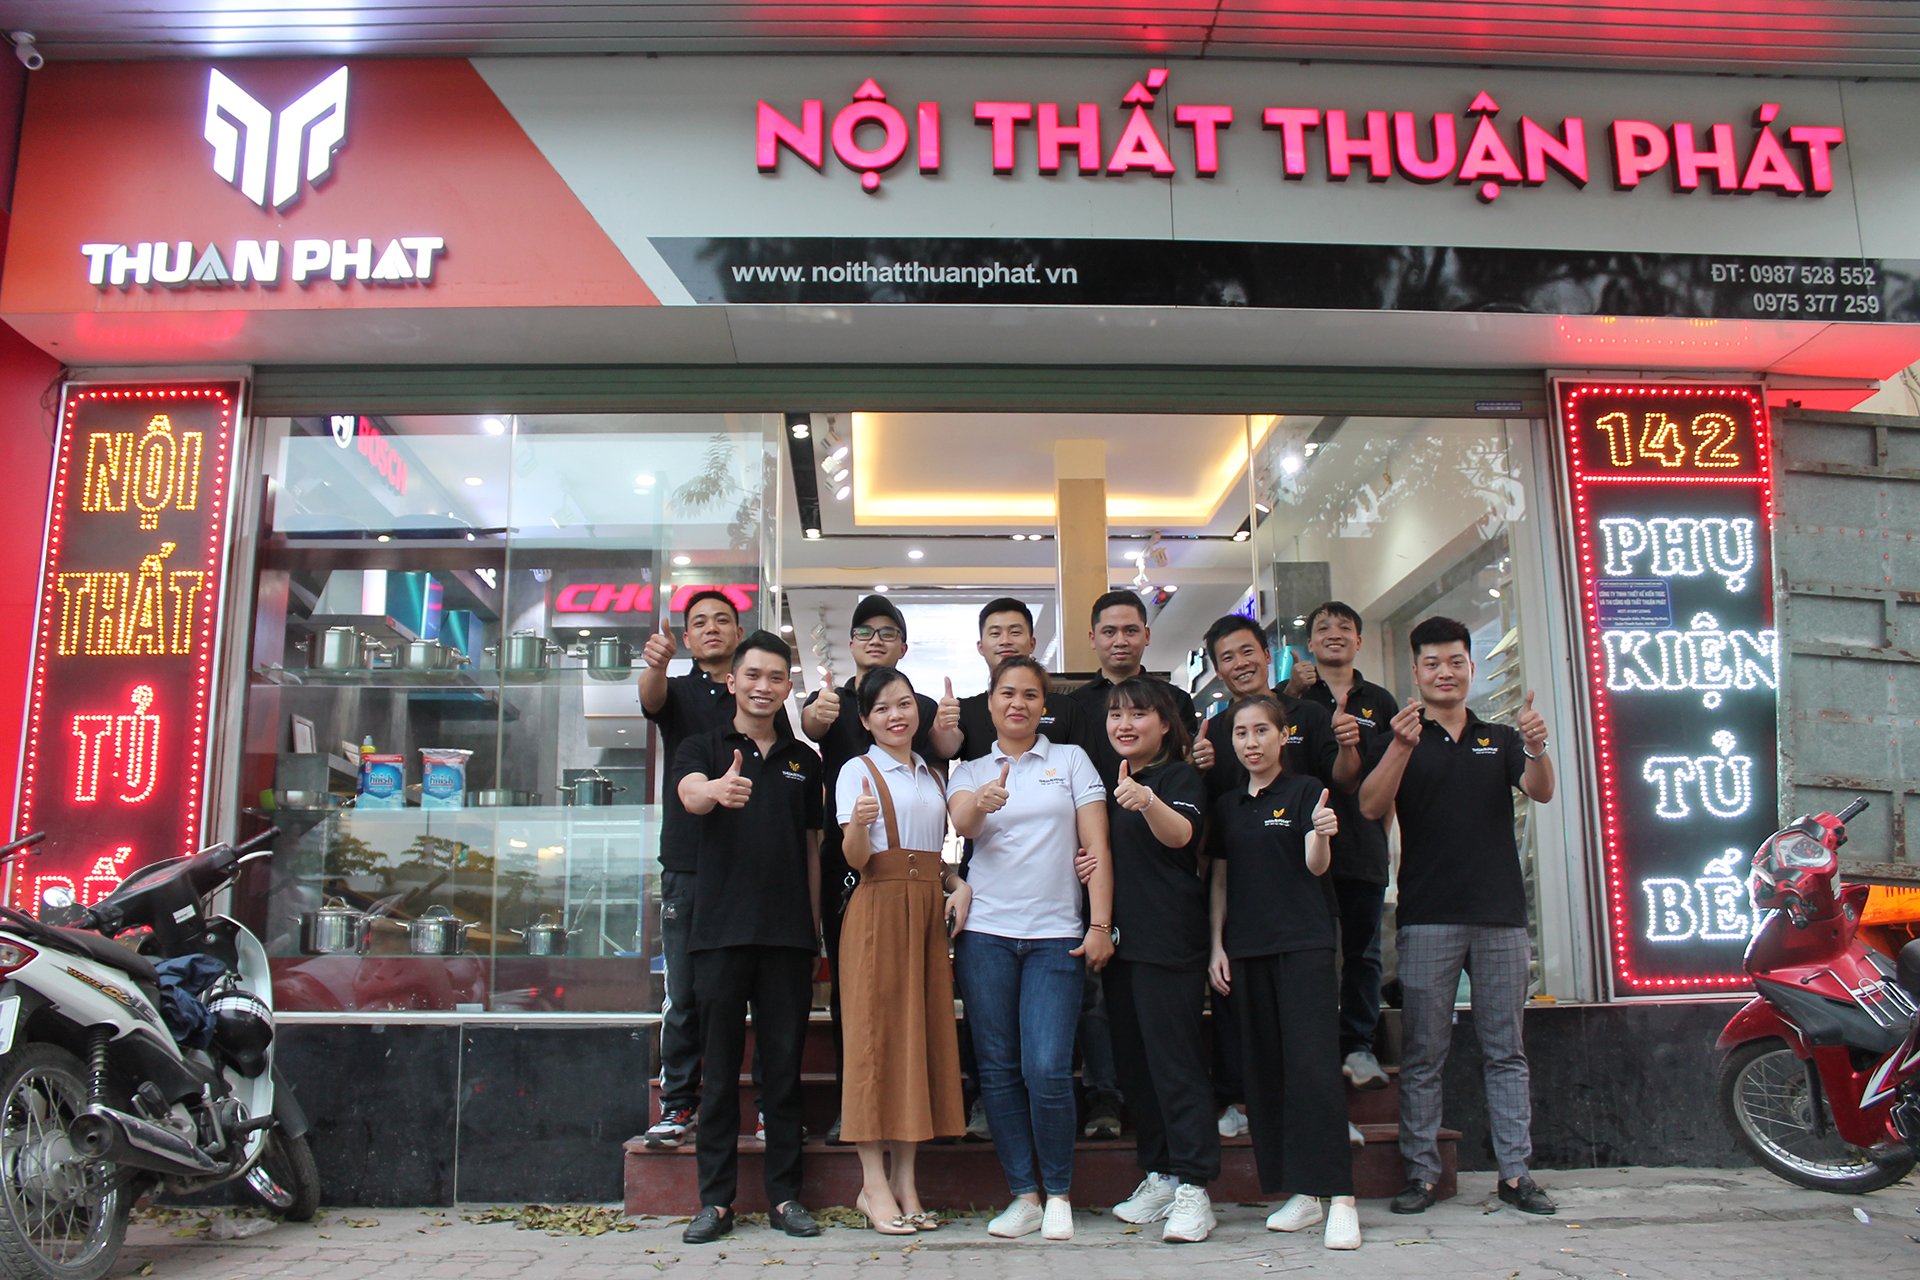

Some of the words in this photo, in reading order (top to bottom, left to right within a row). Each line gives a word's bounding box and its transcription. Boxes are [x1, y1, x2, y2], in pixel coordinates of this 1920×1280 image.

[756, 77, 940, 191] NỘI
[973, 68, 1233, 176] THẤT
[1263, 90, 1589, 202] THUẬN
[1610, 103, 1844, 195] PHÁT
[291, 236, 445, 284] PHAT
[1711, 264, 1745, 283] ĐT:
[1750, 265, 1796, 284] 0987
[1801, 266, 1836, 285] 528
[1840, 267, 1876, 286] 552
[1753, 293, 1800, 312] 0975
[1804, 294, 1839, 313] 377
[1844, 294, 1880, 314] 259
[81, 414, 203, 531] NỘI
[357, 416, 409, 496] BOSCH
[1596, 412, 1741, 468] 142
[57, 541, 205, 656] THẤT
[1598, 517, 1754, 594] PHỤ
[1601, 611, 1779, 709] KIỆN
[72, 684, 161, 803] TỦ
[1642, 729, 1753, 819] TỦ
[1642, 847, 1762, 943] BẾ
